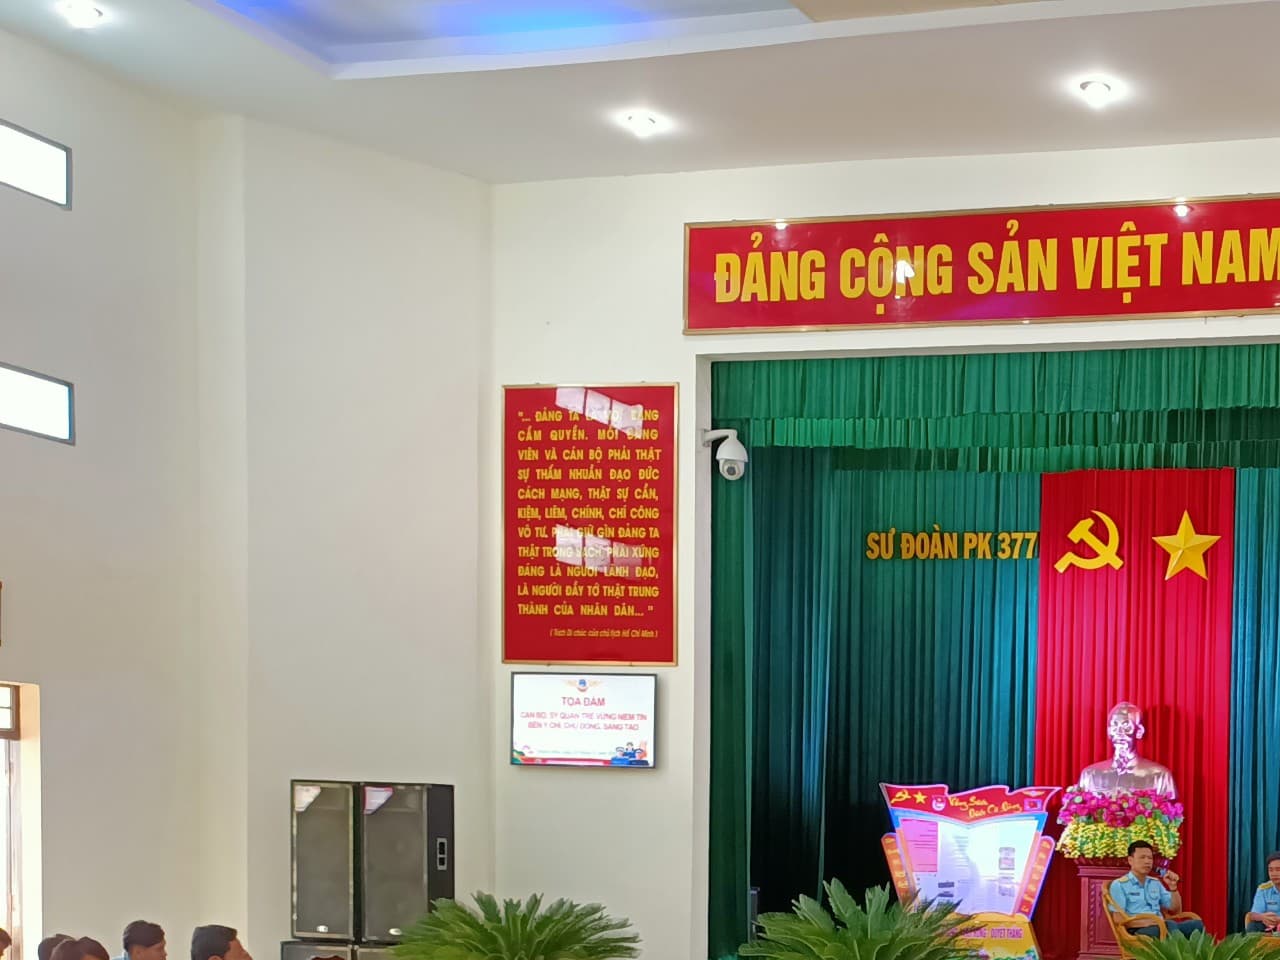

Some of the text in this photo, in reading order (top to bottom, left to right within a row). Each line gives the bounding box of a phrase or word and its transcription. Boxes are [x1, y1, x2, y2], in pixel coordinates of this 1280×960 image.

[714, 232, 825, 302] ĐẢNG
[840, 233, 952, 314] CỘNG
[967, 220, 1057, 293] SẢN
[1072, 221, 1168, 303] VIỆT
[649, 528, 659, 538] TA
[866, 524, 1038, 559] SƯ ĐOÀN PK 377
[629, 586, 659, 597] TRUNG
